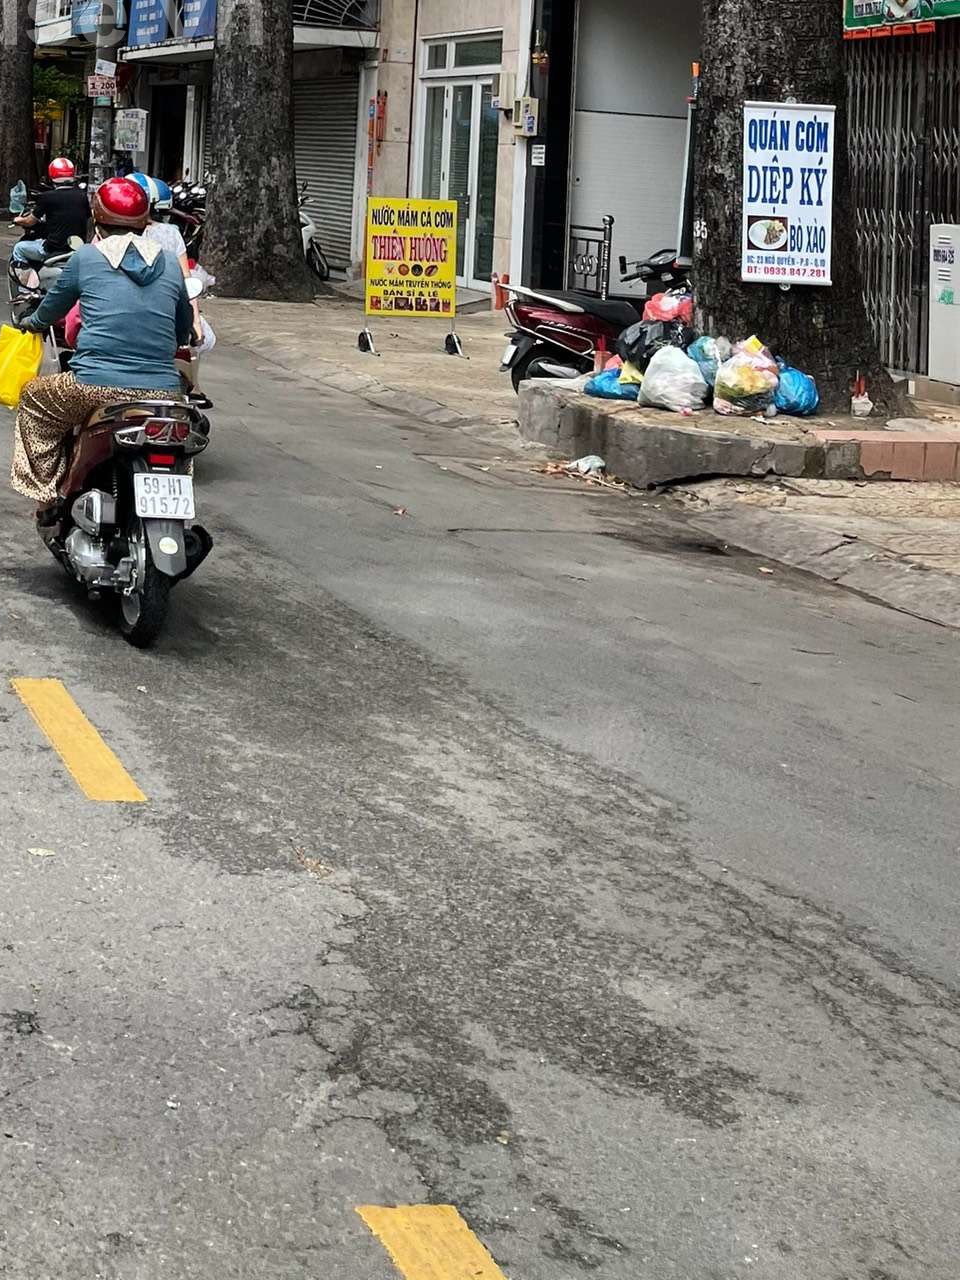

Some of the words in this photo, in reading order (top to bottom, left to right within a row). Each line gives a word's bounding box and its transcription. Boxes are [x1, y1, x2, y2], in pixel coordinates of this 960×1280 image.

[748, 110, 790, 153] QUÁN
[795, 114, 829, 153] CƠM
[747, 154, 794, 215] DIỆP
[799, 156, 828, 207] KÝ
[372, 205, 395, 227] NƯỚC
[397, 202, 418, 227] MẮM
[421, 206, 432, 228] CÁ
[434, 208, 454, 228] CƠM
[372, 228, 407, 261] THIÊN
[409, 232, 449, 263] HƯƠNG
[790, 217, 804, 253] BÒ
[806, 218, 826, 254] XÀO
[370, 277, 387, 287] NƯỚC
[388, 277, 404, 288] MẮM
[763, 266, 826, 278] 0933.847.281
[143, 477, 183, 496] 59-H1
[140, 496, 192, 516] 915.72
